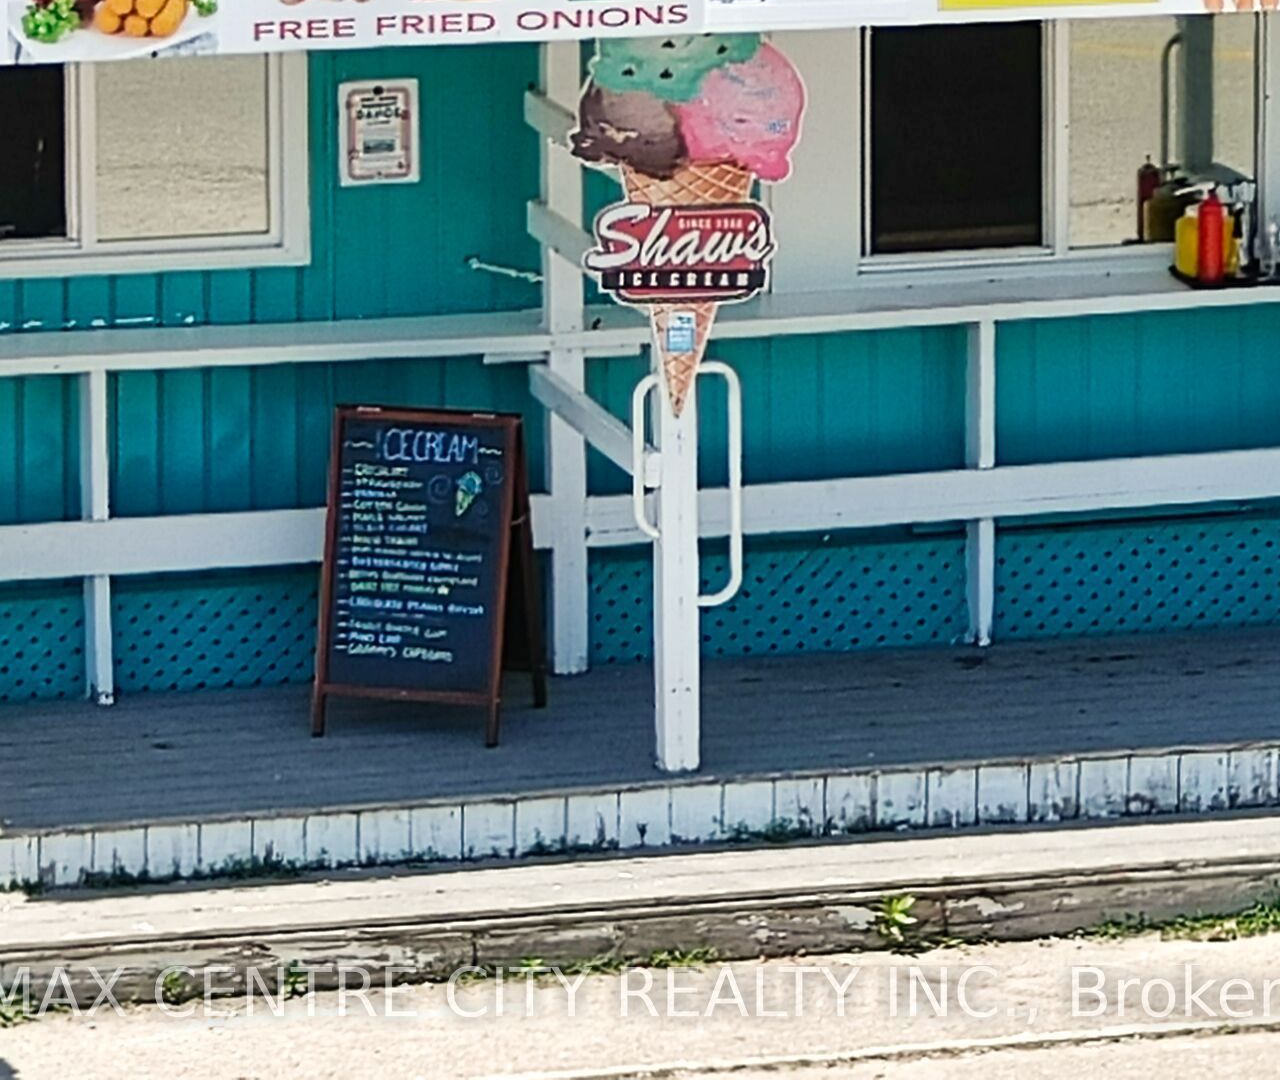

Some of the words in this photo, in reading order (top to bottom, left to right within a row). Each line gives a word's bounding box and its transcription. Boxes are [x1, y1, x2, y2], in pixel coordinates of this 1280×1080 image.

[254, 18, 356, 41] FREE
[376, 13, 495, 35] FRIED
[517, 5, 687, 30] ONIONS
[588, 205, 770, 267] Shaw's
[620, 273, 658, 286] ICE
[670, 273, 749, 286] CREAM
